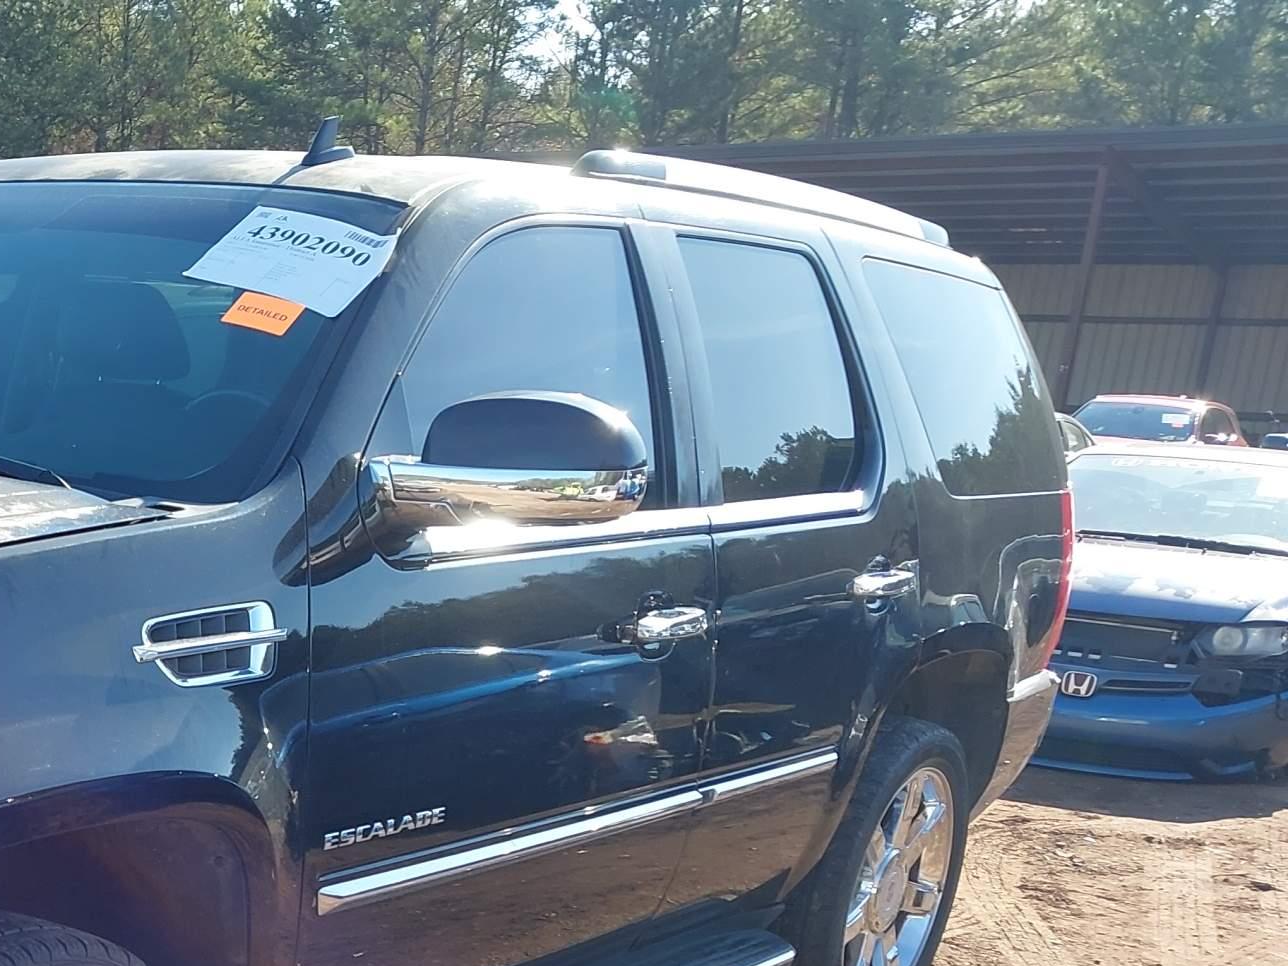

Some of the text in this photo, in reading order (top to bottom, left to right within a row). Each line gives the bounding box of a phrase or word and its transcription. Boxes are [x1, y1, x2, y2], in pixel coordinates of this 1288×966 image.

[247, 224, 372, 267] 43902090
[237, 304, 289, 323] DETAILED
[323, 806, 447, 851] ESCALADE
